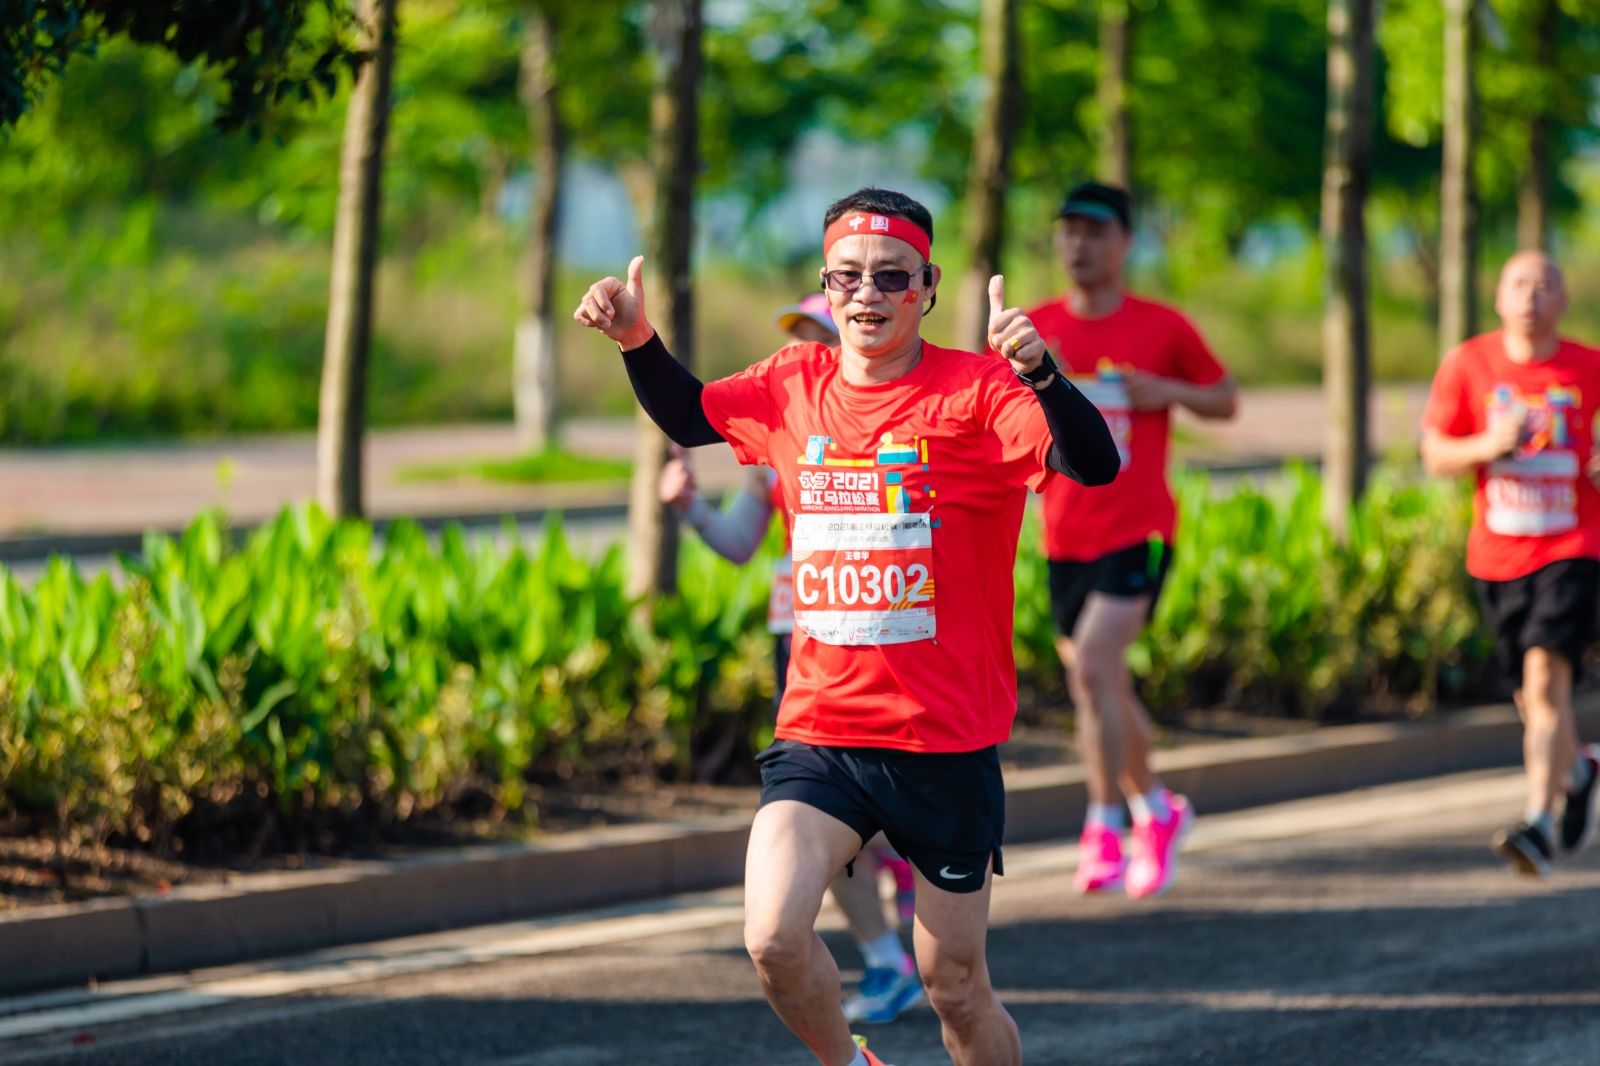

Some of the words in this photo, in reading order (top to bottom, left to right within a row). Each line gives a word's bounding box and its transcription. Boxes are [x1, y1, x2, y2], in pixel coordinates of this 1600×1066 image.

[848, 215, 889, 232] 中国
[832, 471, 879, 491] 2021
[796, 563, 930, 606] C10302
